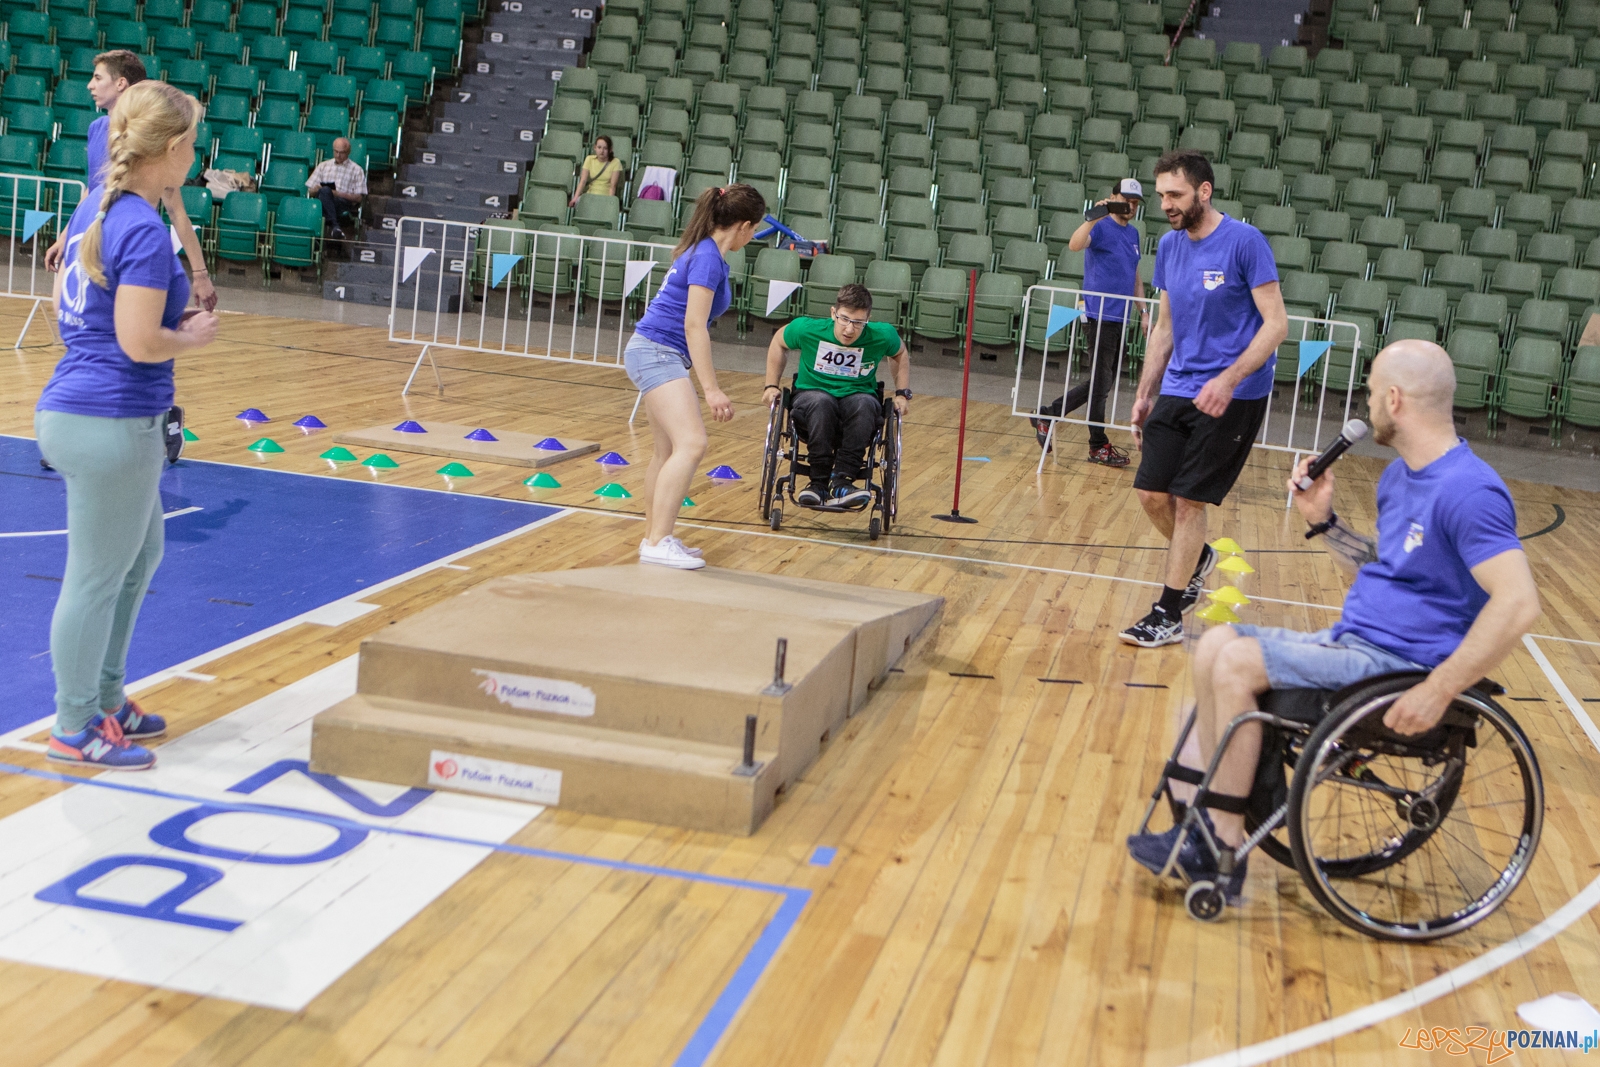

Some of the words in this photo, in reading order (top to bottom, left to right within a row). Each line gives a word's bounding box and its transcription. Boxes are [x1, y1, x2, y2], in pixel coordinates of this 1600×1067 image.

[501, 1, 523, 13] 10
[571, 8, 594, 19] 10
[491, 32, 504, 43] 9
[562, 38, 576, 49] 9
[477, 62, 490, 73] 8
[551, 70, 562, 81] 8
[458, 92, 472, 103] 7
[535, 99, 548, 110] 7
[441, 122, 455, 133] 6
[519, 130, 534, 142] 6
[422, 153, 436, 164] 5
[503, 161, 518, 173] 5
[402, 185, 418, 197] 4
[485, 195, 500, 208] 4
[382, 217, 397, 230] 3
[360, 249, 376, 262] 2
[449, 259, 464, 272] 2
[334, 286, 346, 299] 1
[821, 351, 857, 368] 402
